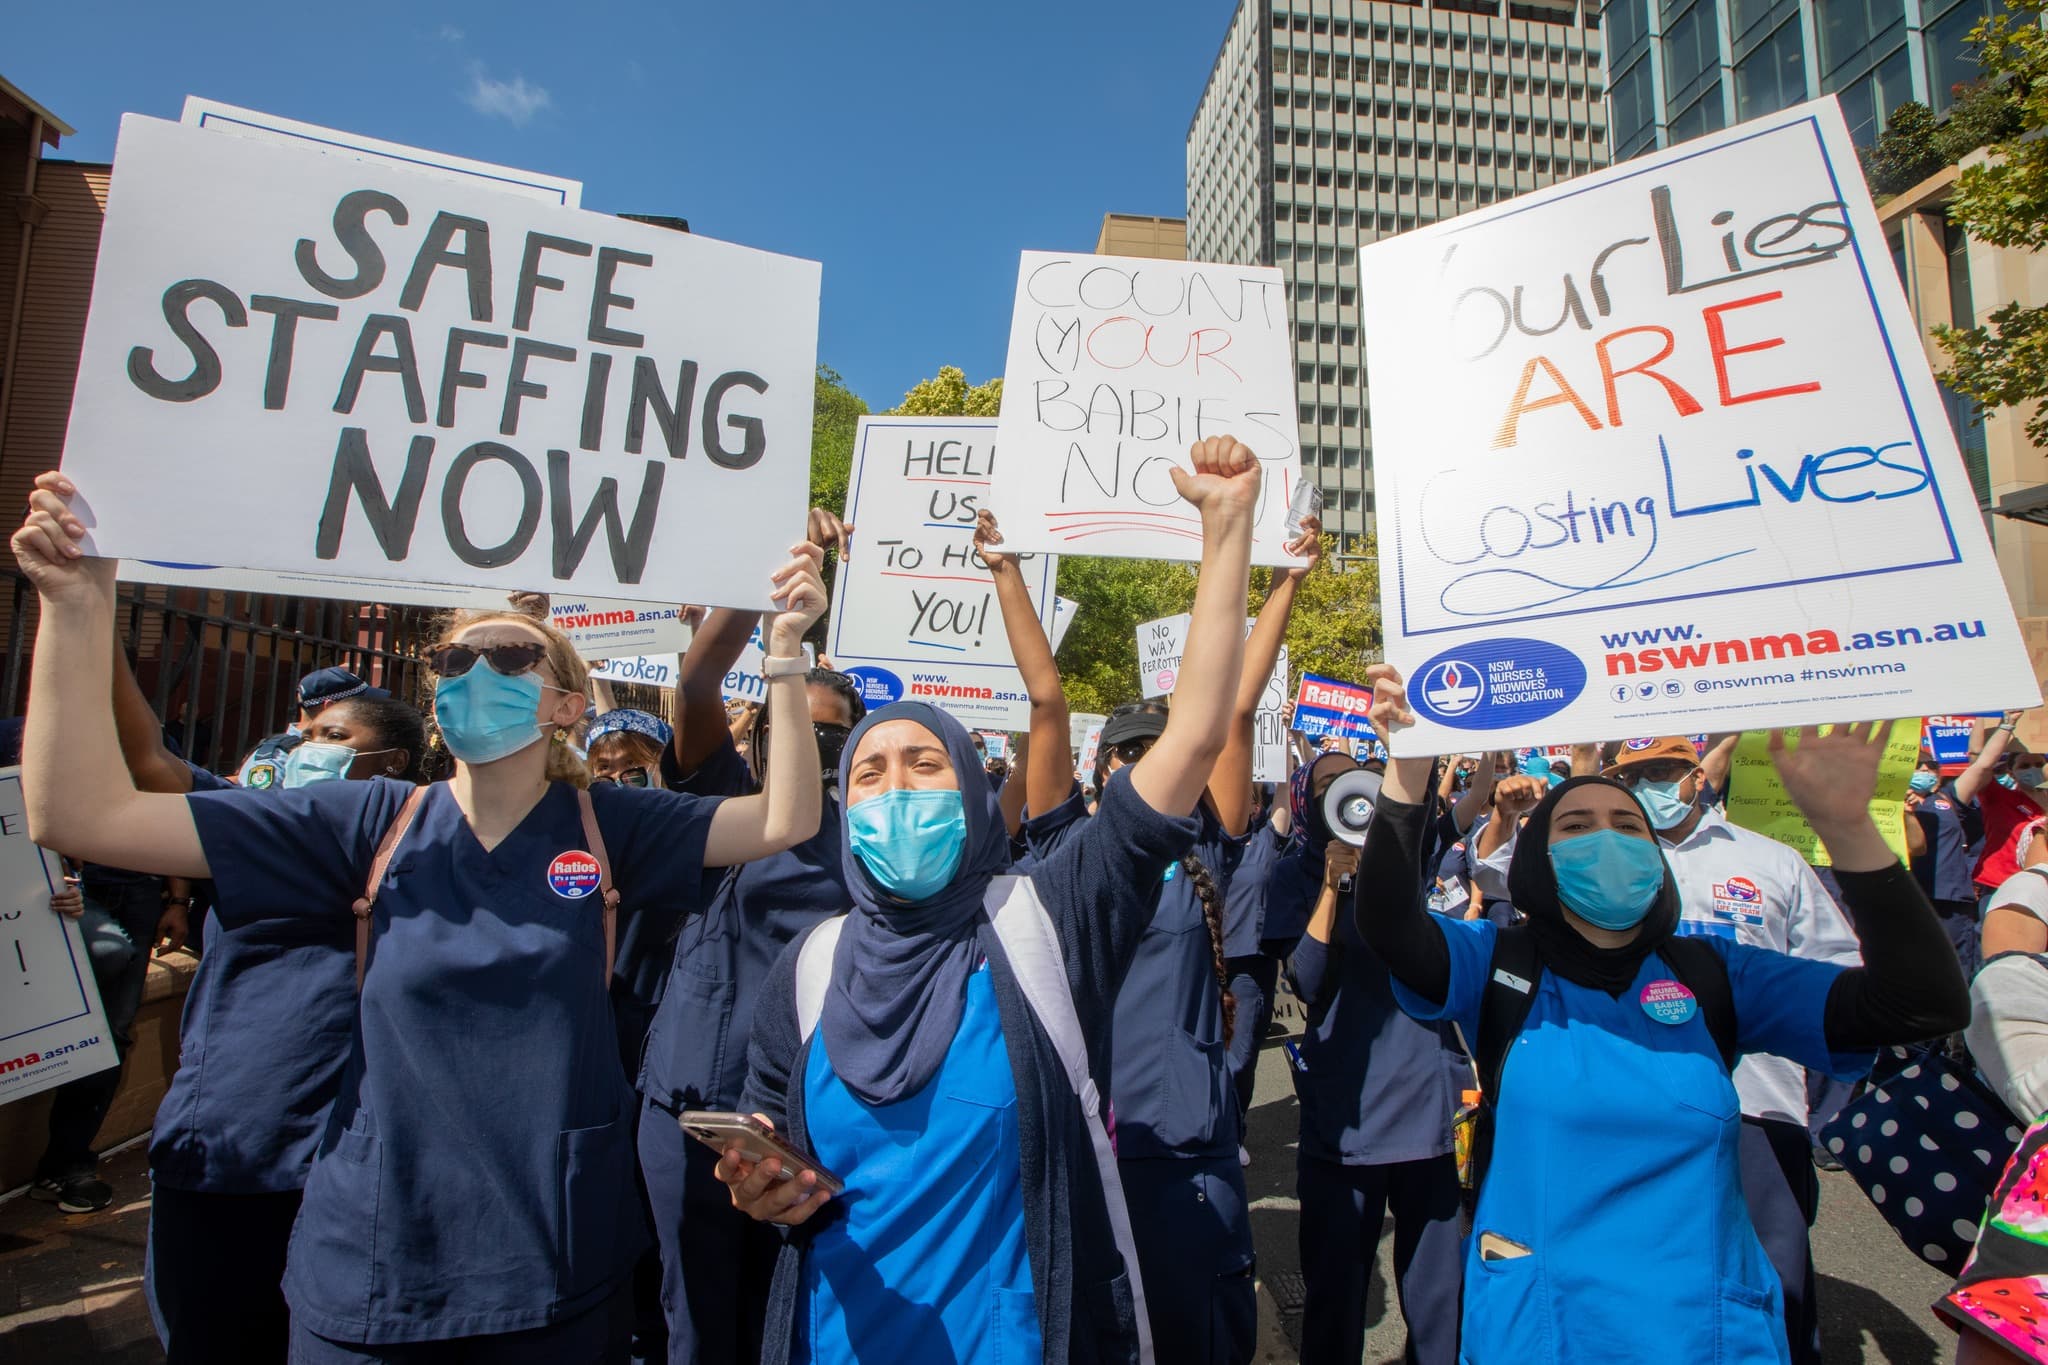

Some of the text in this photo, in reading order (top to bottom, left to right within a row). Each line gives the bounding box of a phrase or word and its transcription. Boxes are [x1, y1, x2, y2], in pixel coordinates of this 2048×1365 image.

[1650, 184, 1853, 296] Lies
[295, 189, 653, 348] SAFE
[1028, 260, 1283, 329] COUNT
[127, 279, 770, 470] STAFFING
[1490, 290, 1821, 451] ARE
[1033, 379, 1294, 460] BABIES
[316, 427, 666, 586] NOW
[928, 489, 978, 523] US
[1420, 434, 1931, 592] Costing Lives
[877, 540, 923, 570] TO
[551, 602, 589, 616] www.
[909, 589, 990, 648] YOU!
[1152, 624, 1170, 640] NO
[1600, 623, 1703, 649] www.
[1148, 638, 1176, 657] WAY
[1605, 620, 1987, 677] nswnma.asn.au
[1142, 656, 1183, 674] PERROTTE
[1488, 660, 1514, 673] NSW
[1489, 668, 1545, 684] NURSES &
[1694, 661, 1906, 693] @nswnma #nswnma
[912, 673, 949, 684] www.
[911, 682, 1030, 702] nswnma.asn.a
[1304, 684, 1369, 713] Ratios
[1491, 688, 1564, 705] ASSOCIATION
[1935, 728, 1973, 738] SUPPO
[554, 861, 597, 874] Ratios
[1650, 986, 1679, 995] MUMS
[1654, 1000, 1686, 1009] BABIES
[1656, 1007, 1688, 1016] COUNT
